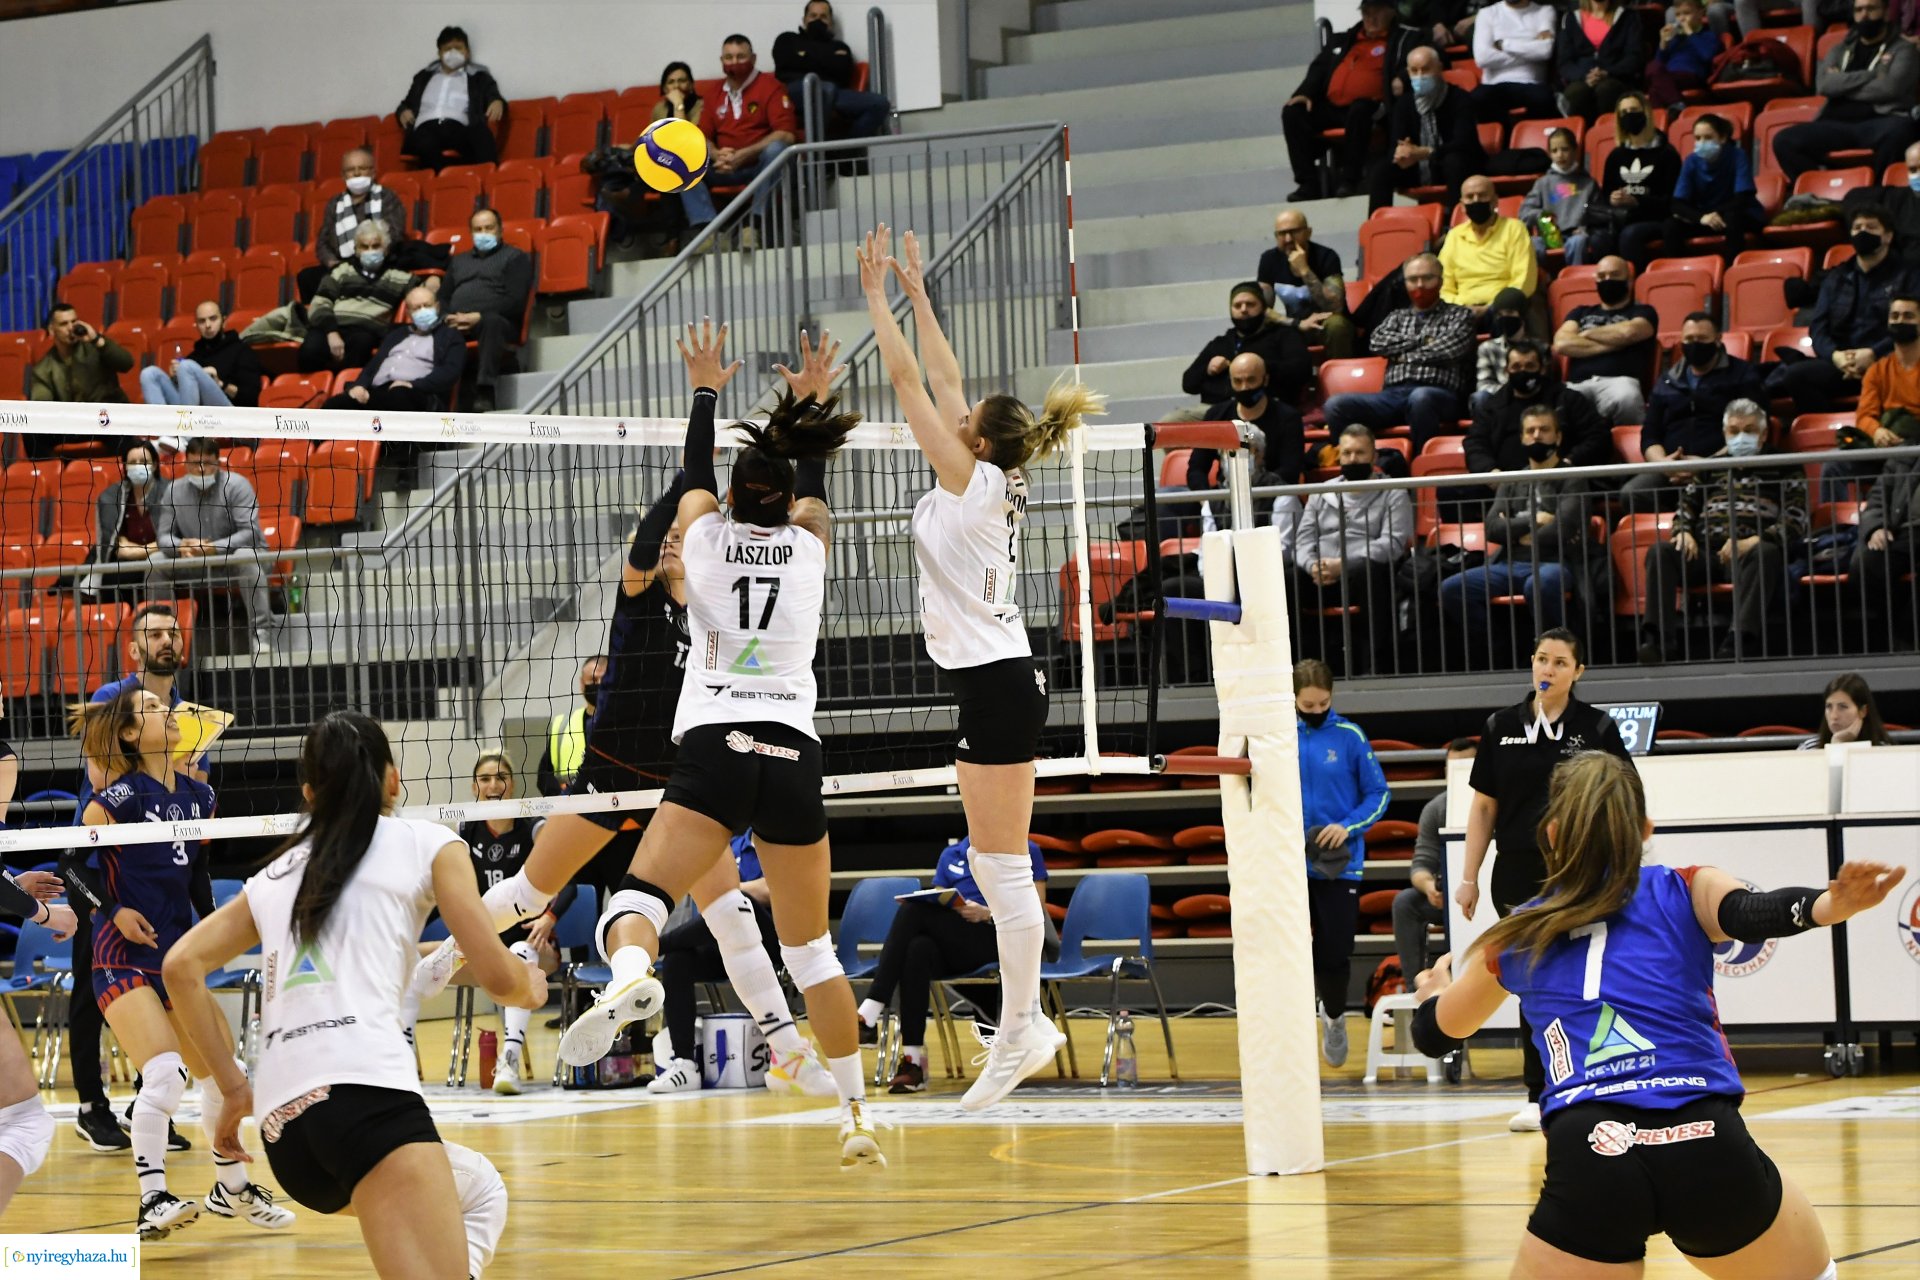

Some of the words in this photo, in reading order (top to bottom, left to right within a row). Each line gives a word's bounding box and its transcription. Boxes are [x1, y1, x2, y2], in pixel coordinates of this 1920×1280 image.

[275, 415, 310, 431] FATUM
[529, 421, 561, 438] FATUM
[986, 568, 995, 604] STRABAG
[731, 576, 780, 630] 17
[708, 631, 717, 671] STRABAG
[731, 690, 797, 701] BESTRONG
[1609, 706, 1656, 719] FATUM
[1500, 736, 1527, 745] Zeus
[439, 807, 466, 820] FATUM
[172, 824, 202, 838] FATUM
[1569, 921, 1608, 1001] 7
[1714, 940, 1777, 976] REGYHAZA
[1639, 1054, 1656, 1069] 21
[1635, 1122, 1715, 1144] REVESZ
